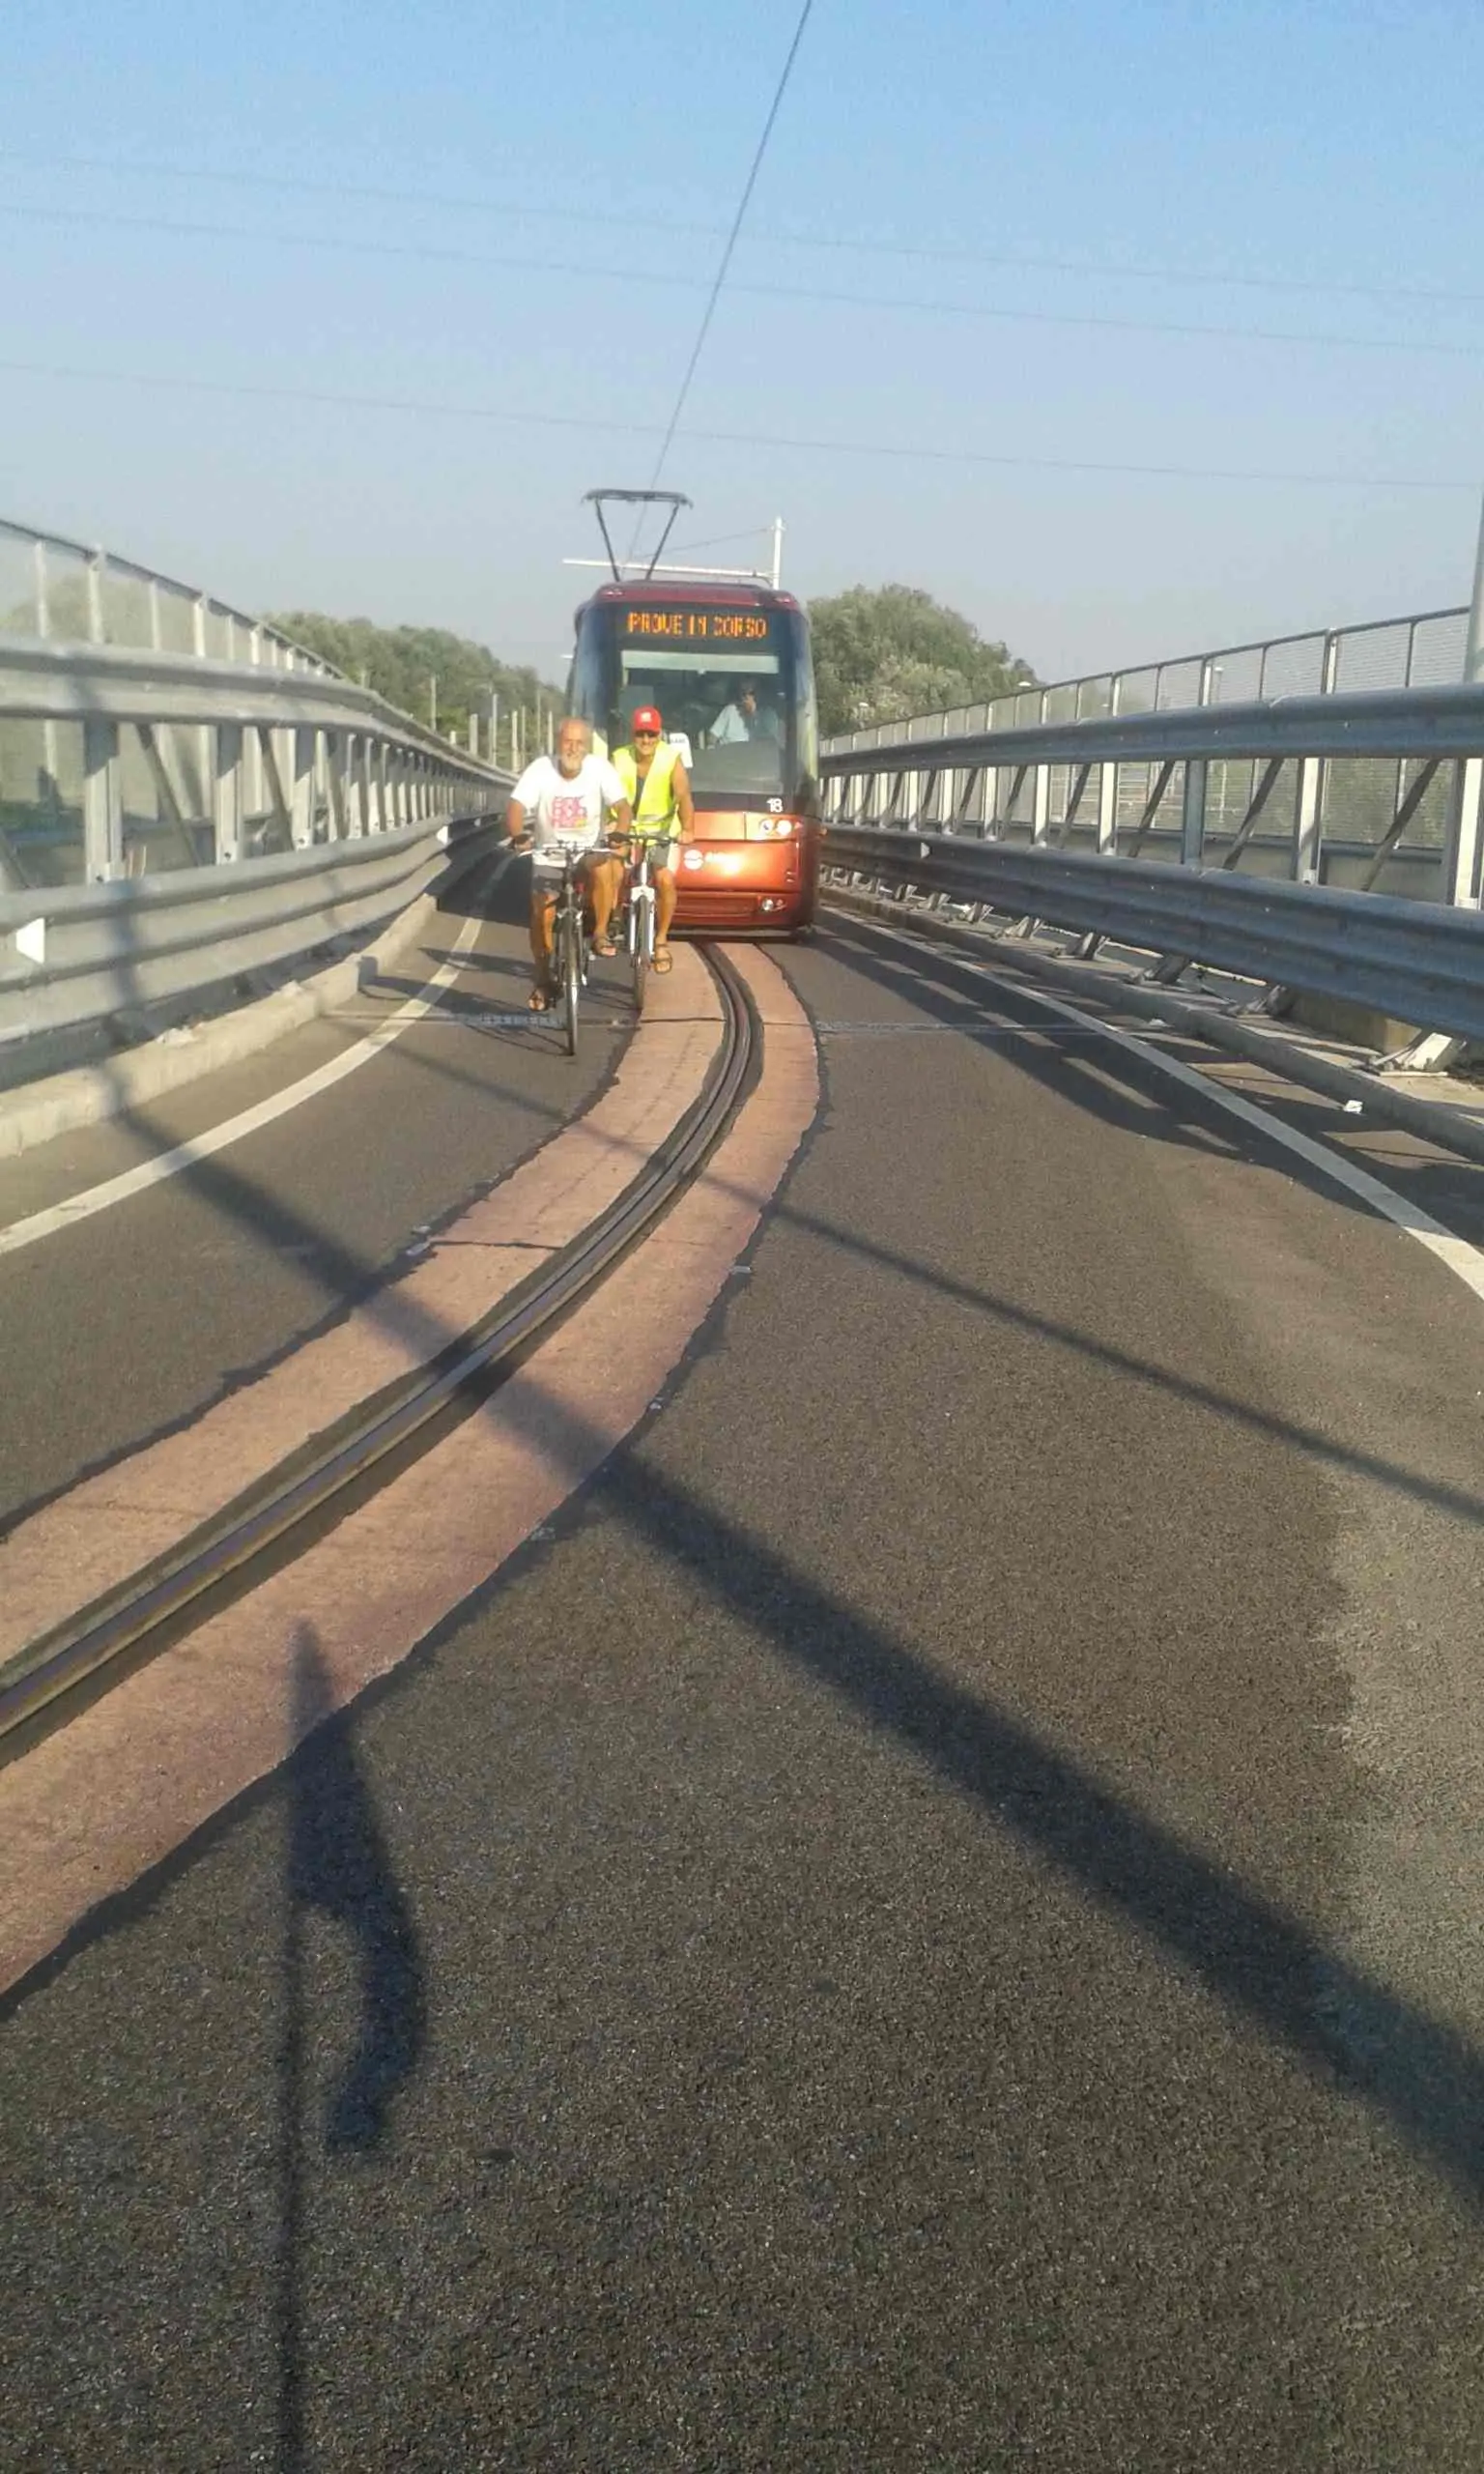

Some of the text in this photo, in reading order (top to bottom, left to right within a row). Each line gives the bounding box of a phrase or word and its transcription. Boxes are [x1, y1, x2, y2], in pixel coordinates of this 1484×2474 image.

[628, 612, 767, 638] PROVE IN CORSO
[766, 797, 784, 813] 18
